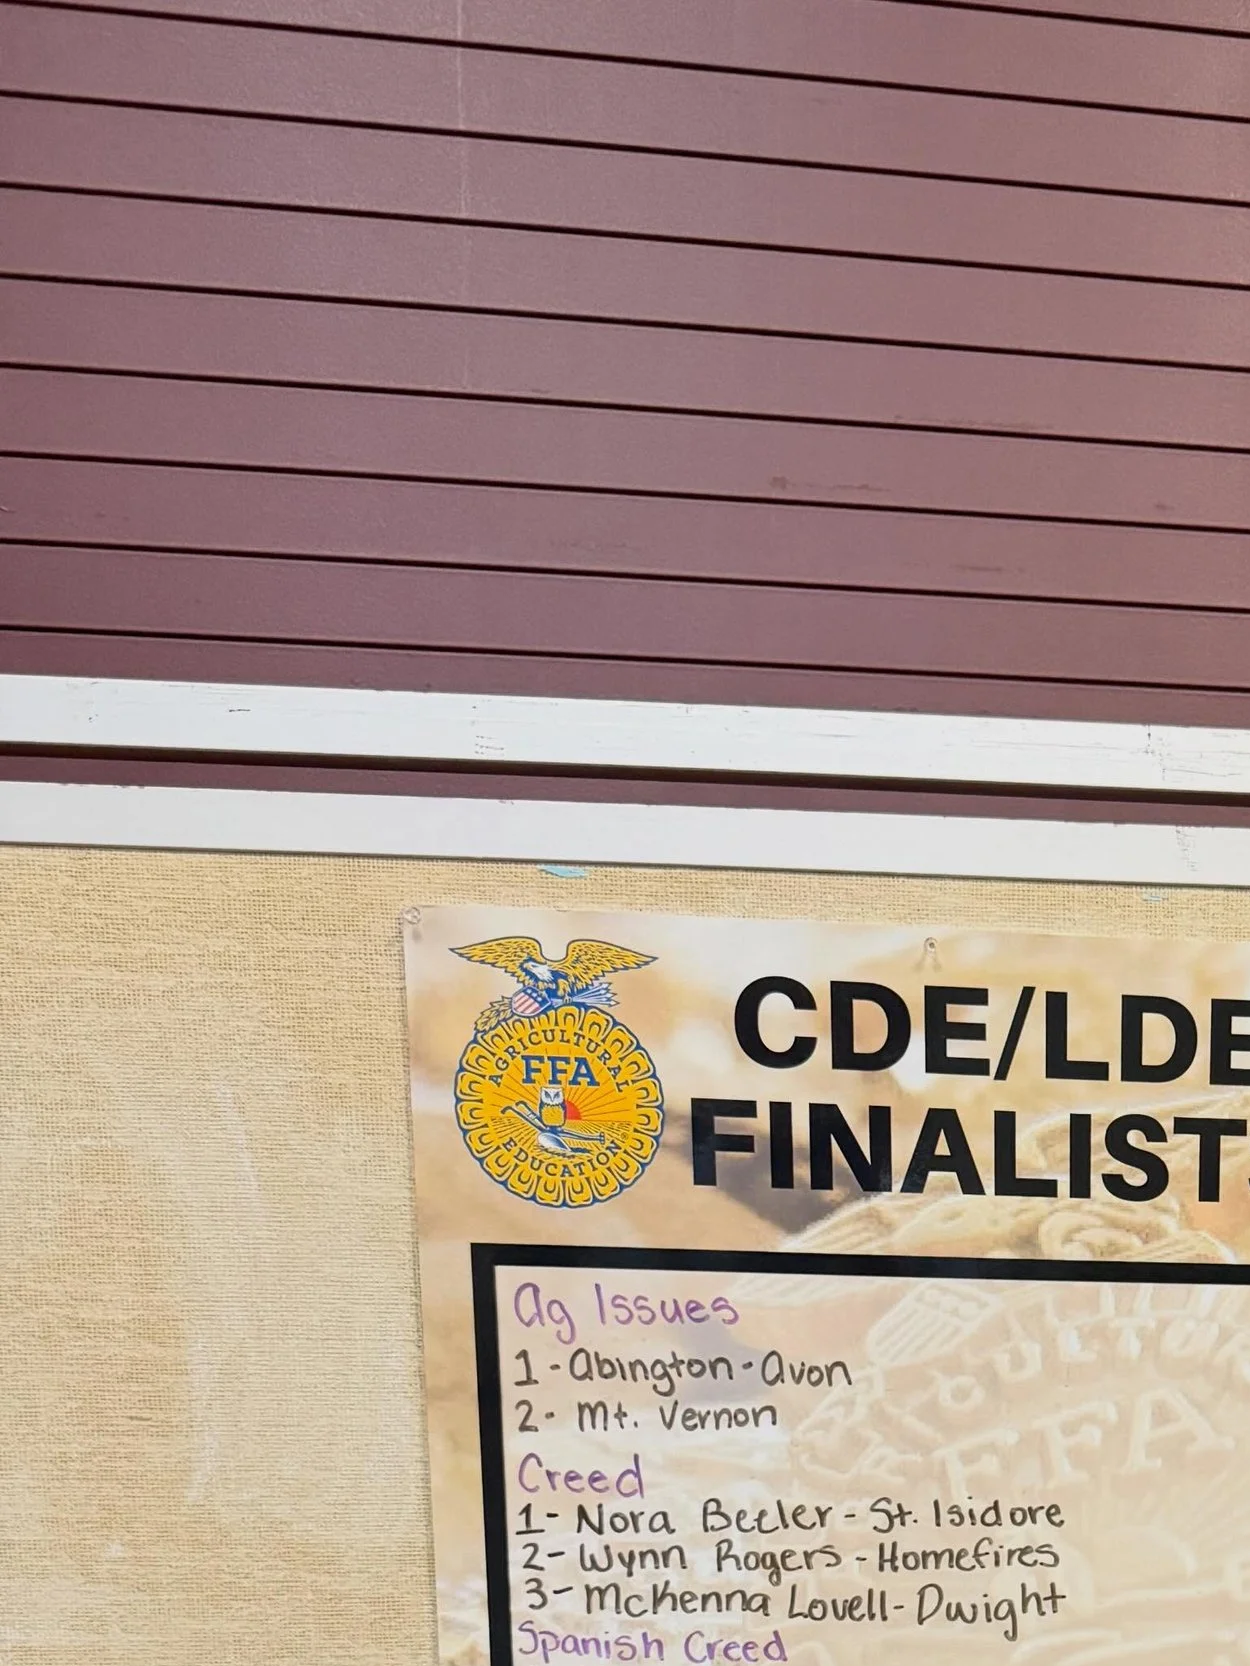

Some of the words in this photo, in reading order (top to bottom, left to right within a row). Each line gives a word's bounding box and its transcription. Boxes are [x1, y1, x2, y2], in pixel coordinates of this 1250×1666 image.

[488, 1029, 632, 1093] AGRICULTURAL
[521, 1055, 600, 1087] FFA
[501, 1138, 622, 1178] EDUCATION
[595, 1283, 739, 1326] Issues
[659, 1402, 779, 1432] Vernon
[518, 1453, 645, 1498] Creed
[576, 1505, 676, 1536] Nora
[933, 1496, 1065, 1529] Isidore
[580, 1543, 687, 1578] Wynn
[518, 1620, 665, 1664] Spanish
[684, 1630, 788, 1663] Creed
